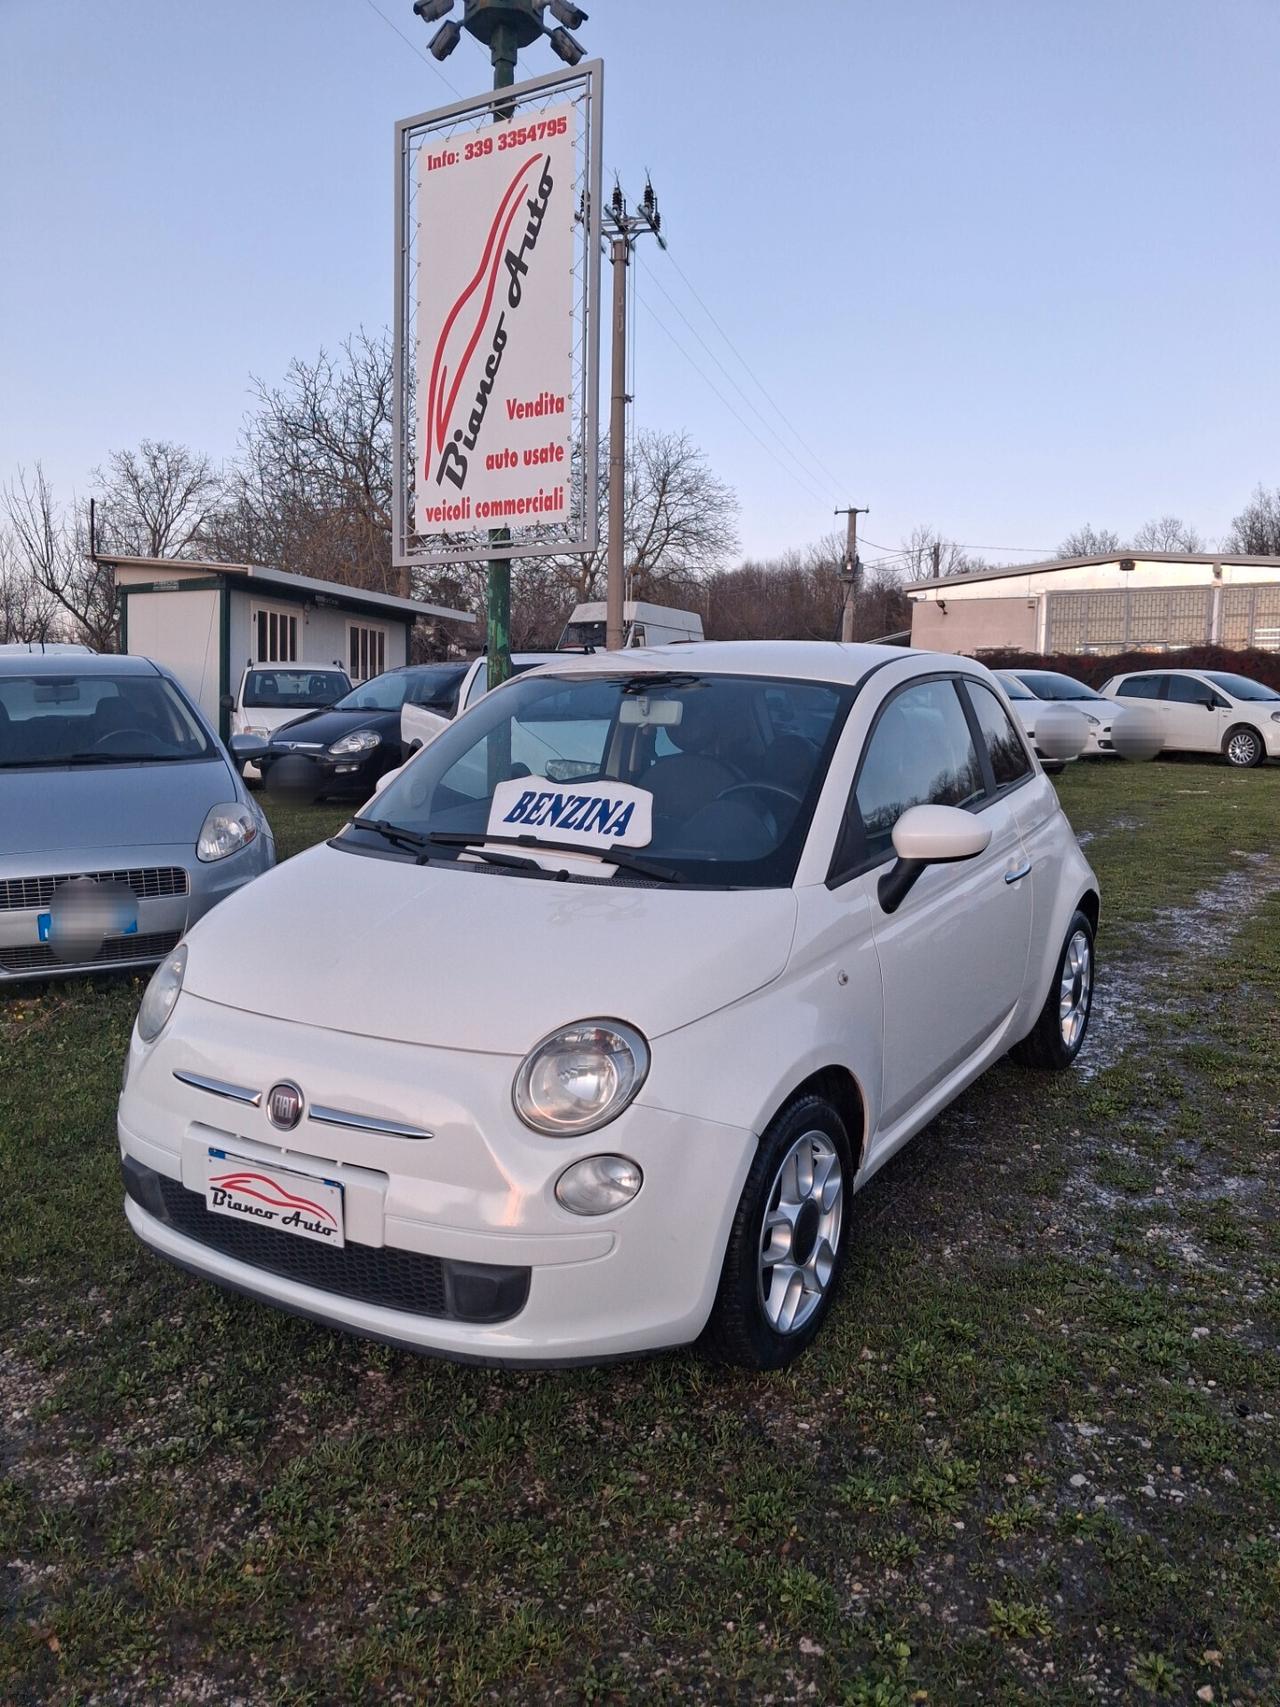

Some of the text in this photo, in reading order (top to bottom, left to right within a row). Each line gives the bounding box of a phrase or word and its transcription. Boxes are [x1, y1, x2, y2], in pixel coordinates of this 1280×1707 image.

[427, 116, 568, 172] Info: 339 3354795
[435, 154, 554, 491] Bianco Auto
[505, 391, 566, 421] Vendita
[485, 442, 565, 472] auto usate
[425, 486, 565, 523] veicoli commerciali
[503, 791, 635, 837] BENZINA
[273, 1094, 296, 1119] FIAT
[210, 1186, 338, 1237] Bianco Auto
